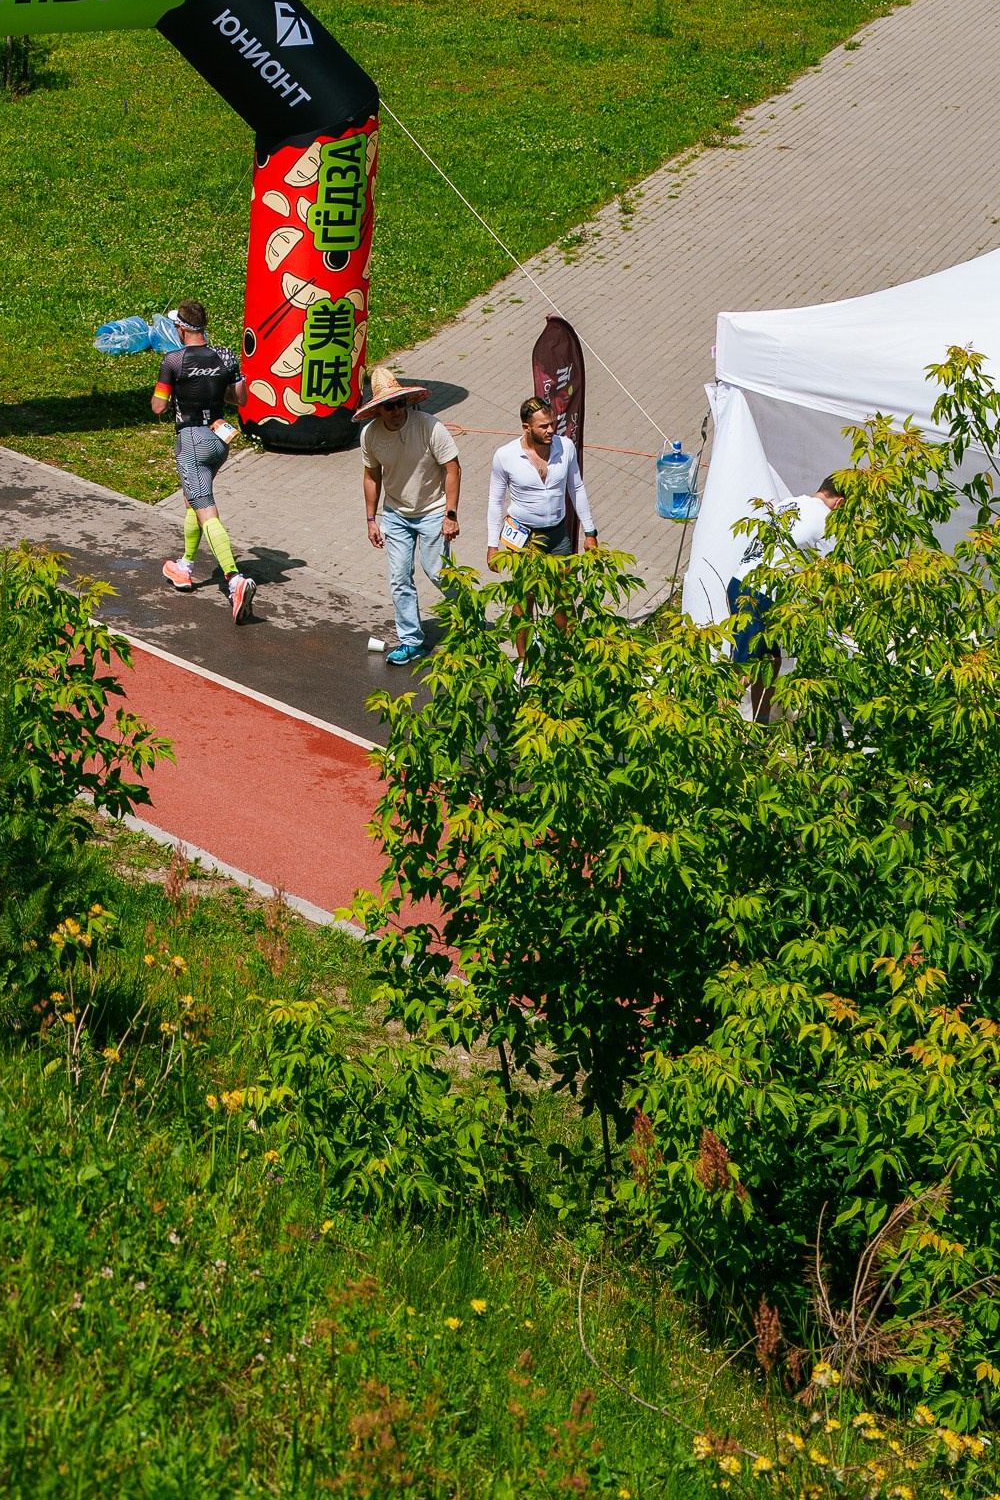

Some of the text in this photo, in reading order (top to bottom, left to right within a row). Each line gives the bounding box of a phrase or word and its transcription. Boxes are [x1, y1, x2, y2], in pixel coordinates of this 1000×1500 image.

[314, 140, 363, 244] ГЁДЗА
[306, 303, 351, 402] 美味
[503, 524, 519, 541] 101
